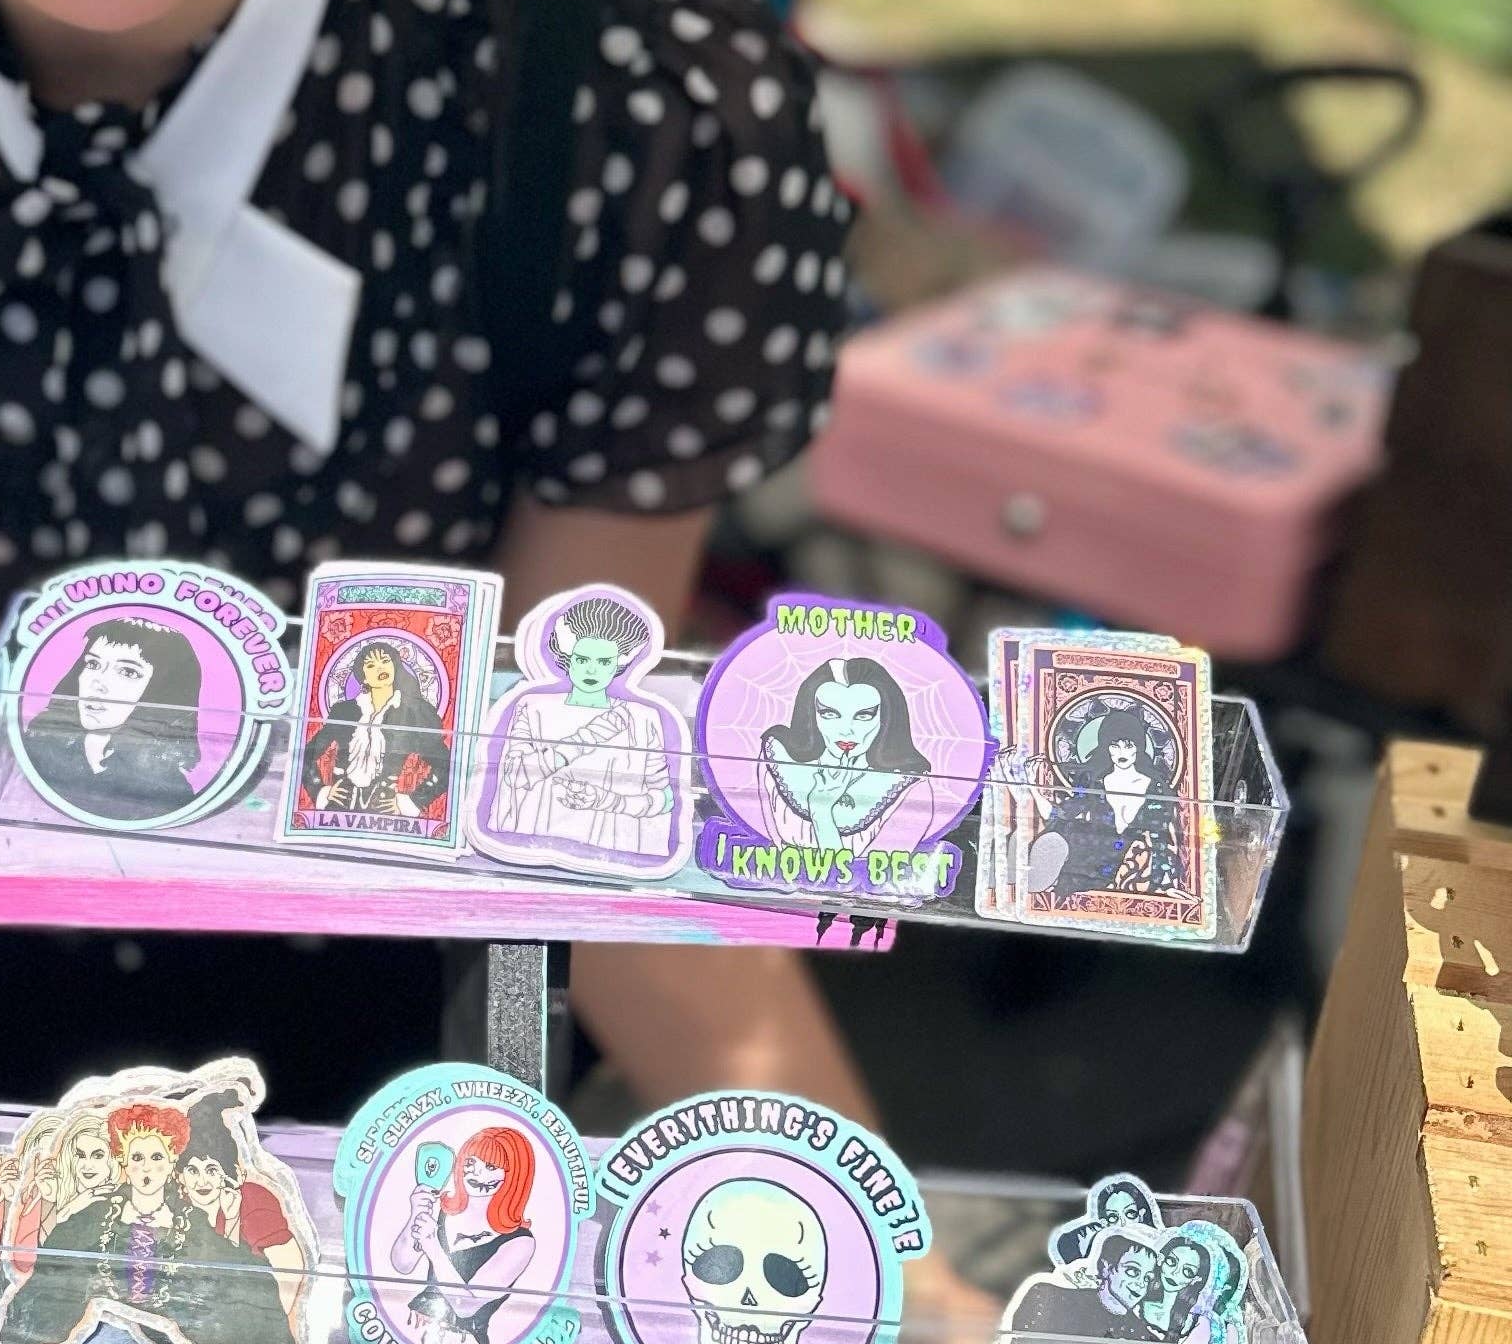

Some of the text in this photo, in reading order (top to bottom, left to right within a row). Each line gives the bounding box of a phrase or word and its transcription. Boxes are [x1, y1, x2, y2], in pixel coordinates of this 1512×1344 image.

[64, 572, 165, 602] WINO
[175, 580, 286, 694] FOREVER
[777, 605, 917, 643] MOTHER
[318, 812, 423, 835] LA VAMPIRA
[732, 844, 855, 884] KNOWS
[868, 849, 956, 887] BEST
[540, 1109, 591, 1215] BEAUTIFUL
[607, 1096, 905, 1217] EVERYTHING'S FINE
